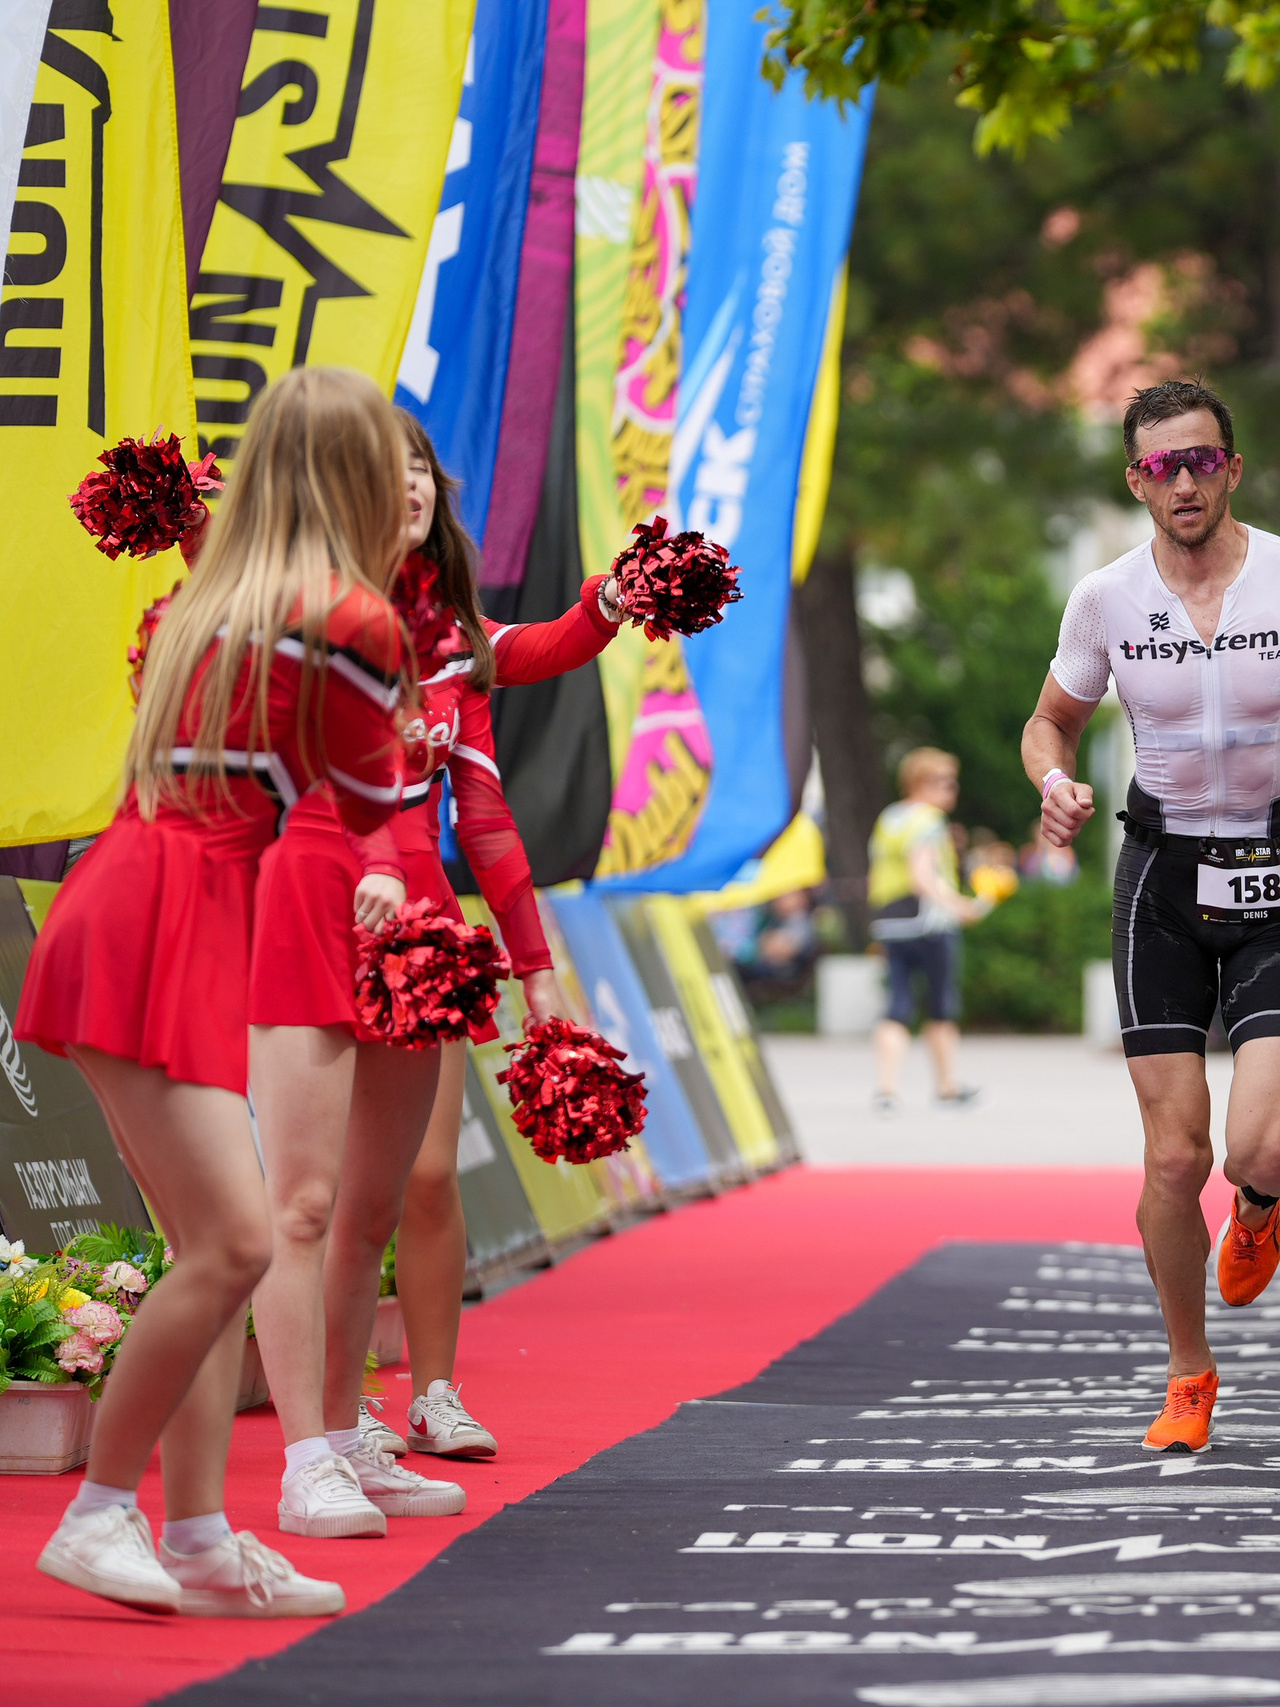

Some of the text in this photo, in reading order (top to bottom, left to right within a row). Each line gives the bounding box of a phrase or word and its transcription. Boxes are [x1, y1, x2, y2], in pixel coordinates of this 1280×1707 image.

[771, 141, 811, 227] ДОМ
[190, 272, 284, 497] ON
[686, 417, 757, 551] СК
[1235, 848, 1250, 857] IRO
[1255, 847, 1271, 856] STAR
[1243, 910, 1269, 919] DENIS
[13, 1158, 102, 1210] ГАЗПРОМБАНК
[788, 1455, 1098, 1470] IRON
[692, 1531, 1050, 1550] IRON
[560, 1631, 979, 1651] IRON
